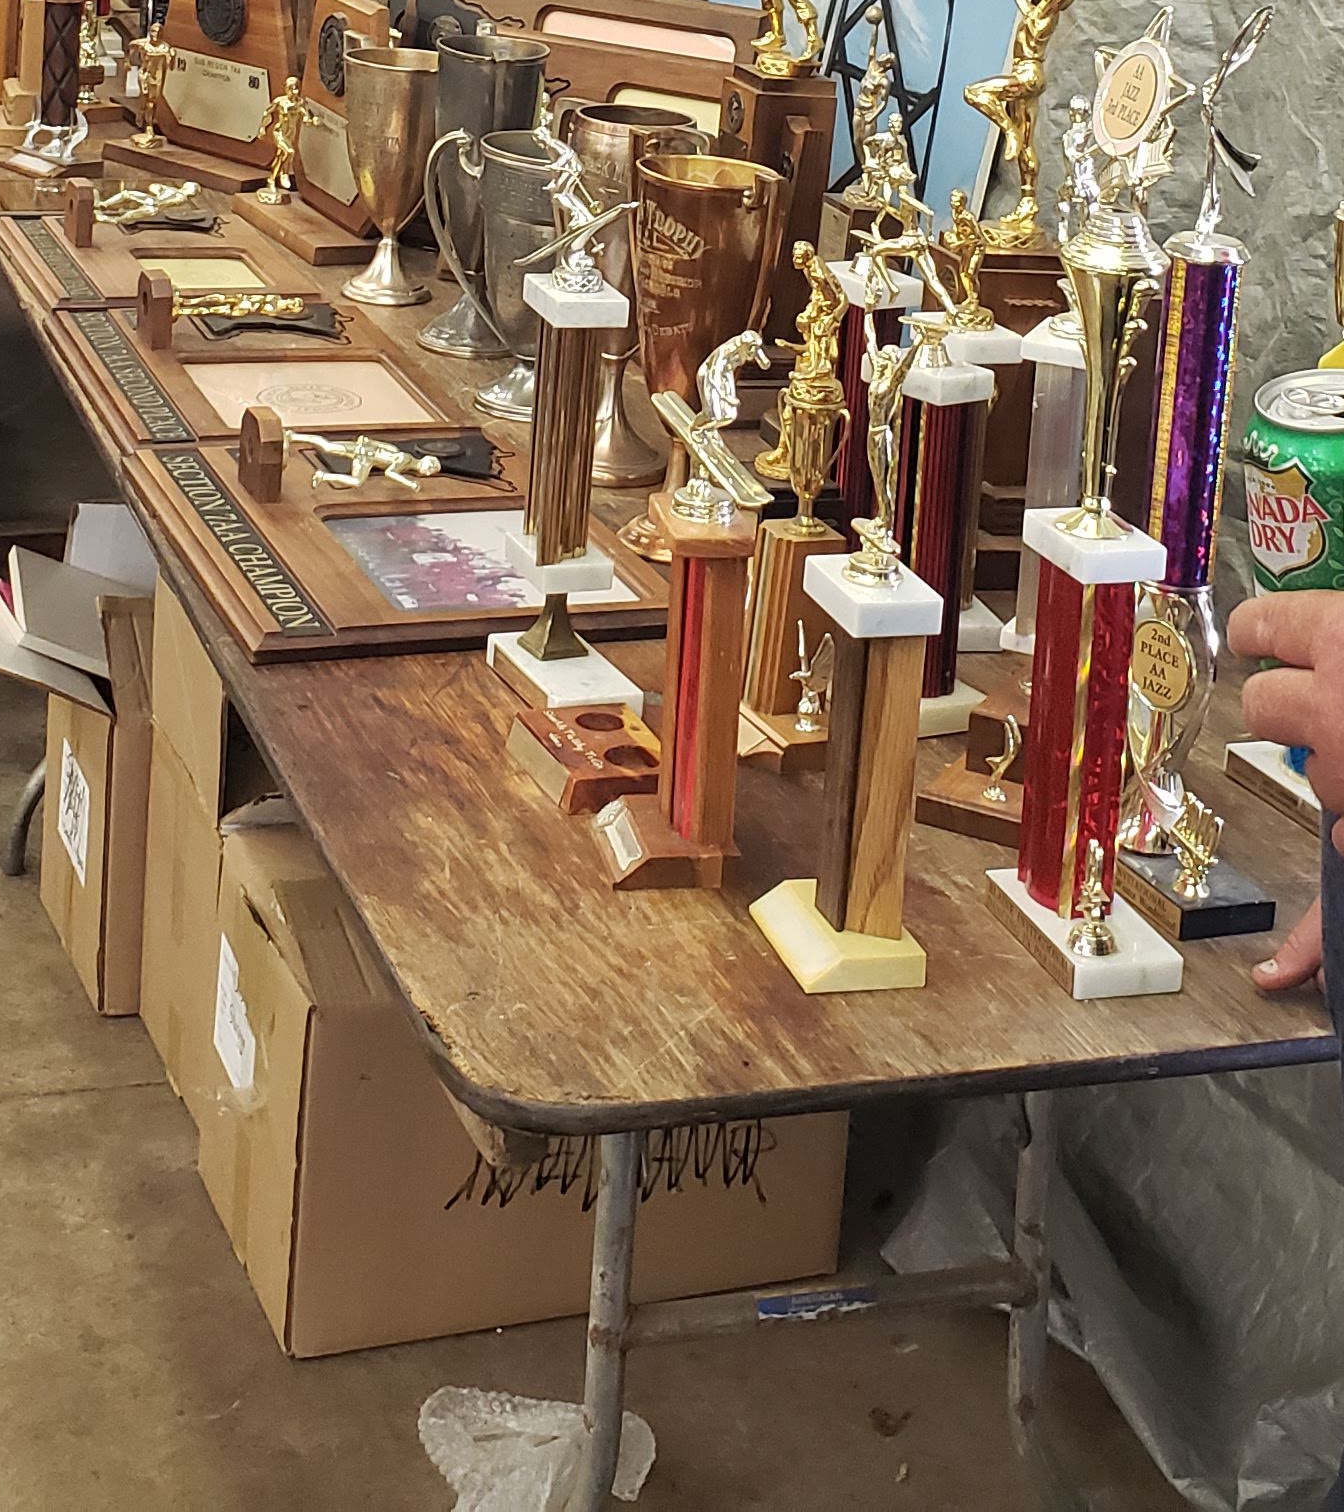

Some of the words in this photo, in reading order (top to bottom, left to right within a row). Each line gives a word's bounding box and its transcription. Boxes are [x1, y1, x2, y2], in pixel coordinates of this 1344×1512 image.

[1117, 104, 1141, 127] PLACE
[111, 366, 165, 406] SECOND
[138, 406, 187, 438] PLACE
[162, 455, 231, 511] SECTION
[1247, 491, 1330, 523] NADA
[202, 513, 255, 542] 7AA
[1251, 519, 1295, 554] DRY
[225, 543, 322, 629] CHAMPION
[1150, 628, 1172, 648] 2nd
[1140, 641, 1180, 669] PLACE
[1149, 662, 1167, 681] AA
[1141, 675, 1173, 700] JAZZ
